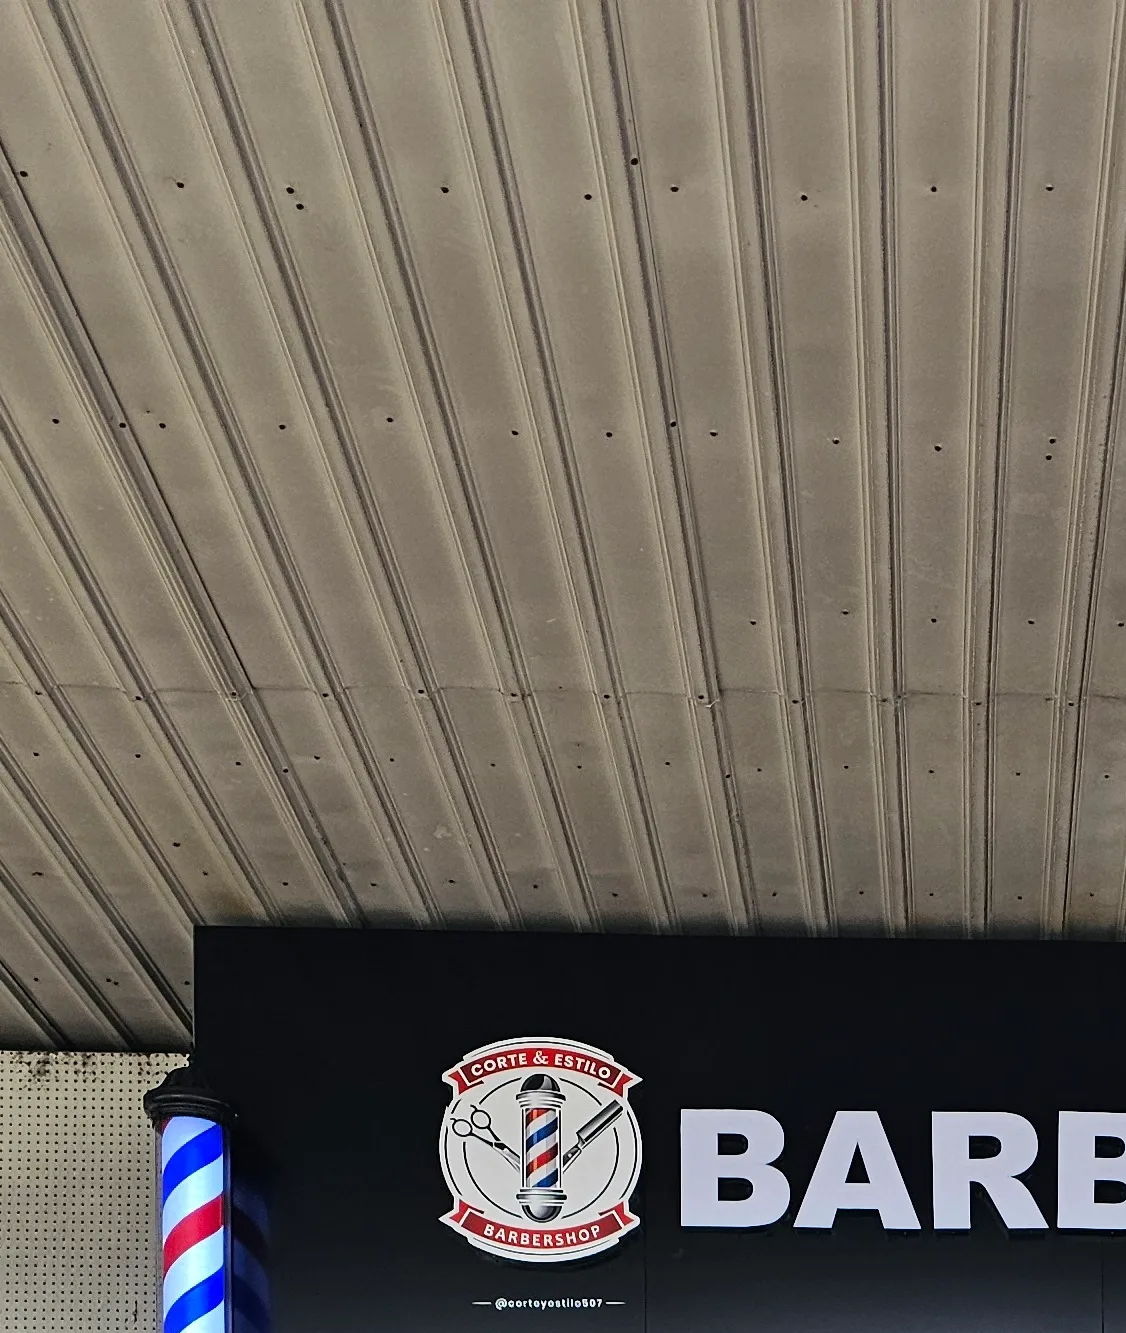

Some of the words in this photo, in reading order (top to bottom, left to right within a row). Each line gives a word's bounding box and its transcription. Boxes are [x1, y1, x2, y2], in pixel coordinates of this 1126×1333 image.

[470, 1052, 528, 1077] CORTE
[532, 1050, 549, 1066] &
[554, 1053, 612, 1080] ESTILO
[483, 1223, 602, 1247] BARBERSHOP
